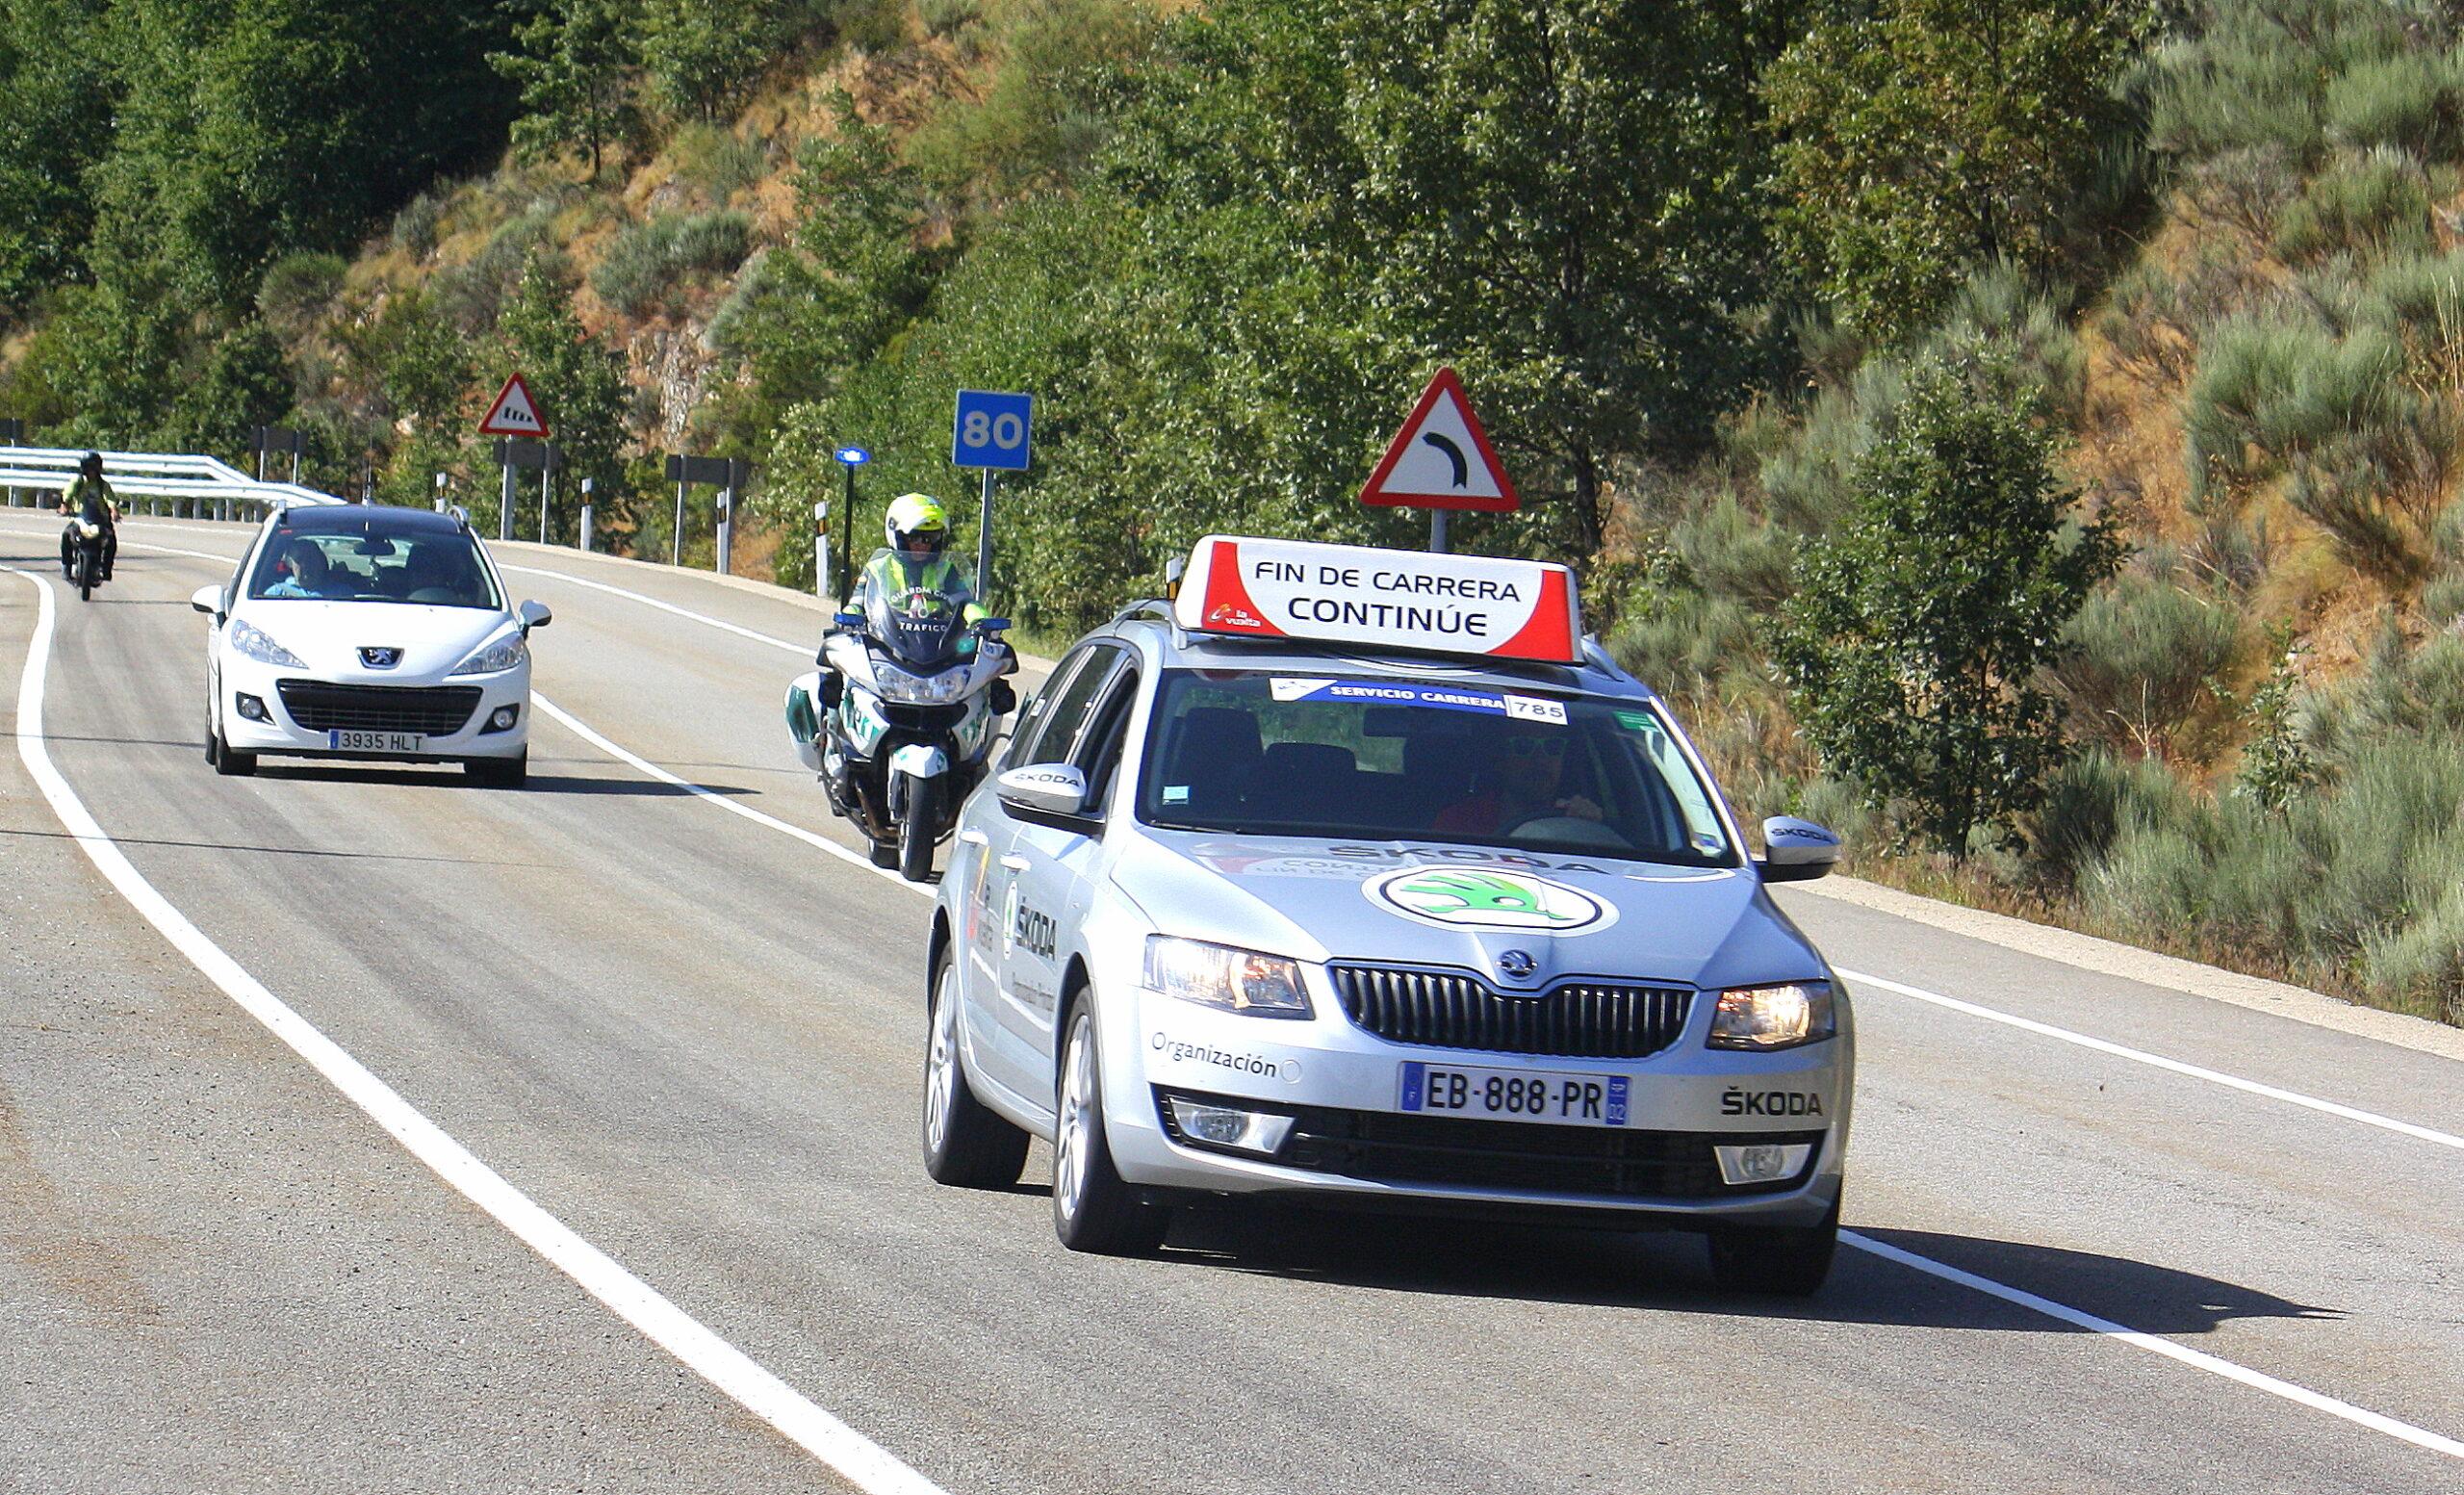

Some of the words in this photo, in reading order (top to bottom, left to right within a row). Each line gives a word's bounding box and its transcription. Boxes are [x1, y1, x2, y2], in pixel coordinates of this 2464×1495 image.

[962, 410, 1023, 451] 80
[1255, 561, 1305, 583] FIN
[1319, 566, 1360, 588] DE
[1373, 572, 1521, 603] CARRERA
[1236, 608, 1248, 618] la
[1288, 597, 1488, 637] CONTINÚE
[1330, 685, 1416, 701] SERVICIO
[1420, 691, 1505, 710] CARRERA
[1514, 702, 1564, 718] 785
[342, 733, 384, 749] 3935
[390, 735, 423, 751] HLT
[1151, 1031, 1277, 1078] Organización
[1427, 1071, 1602, 1120] EB-888-PR
[1720, 1085, 1824, 1117] ŠKODA
